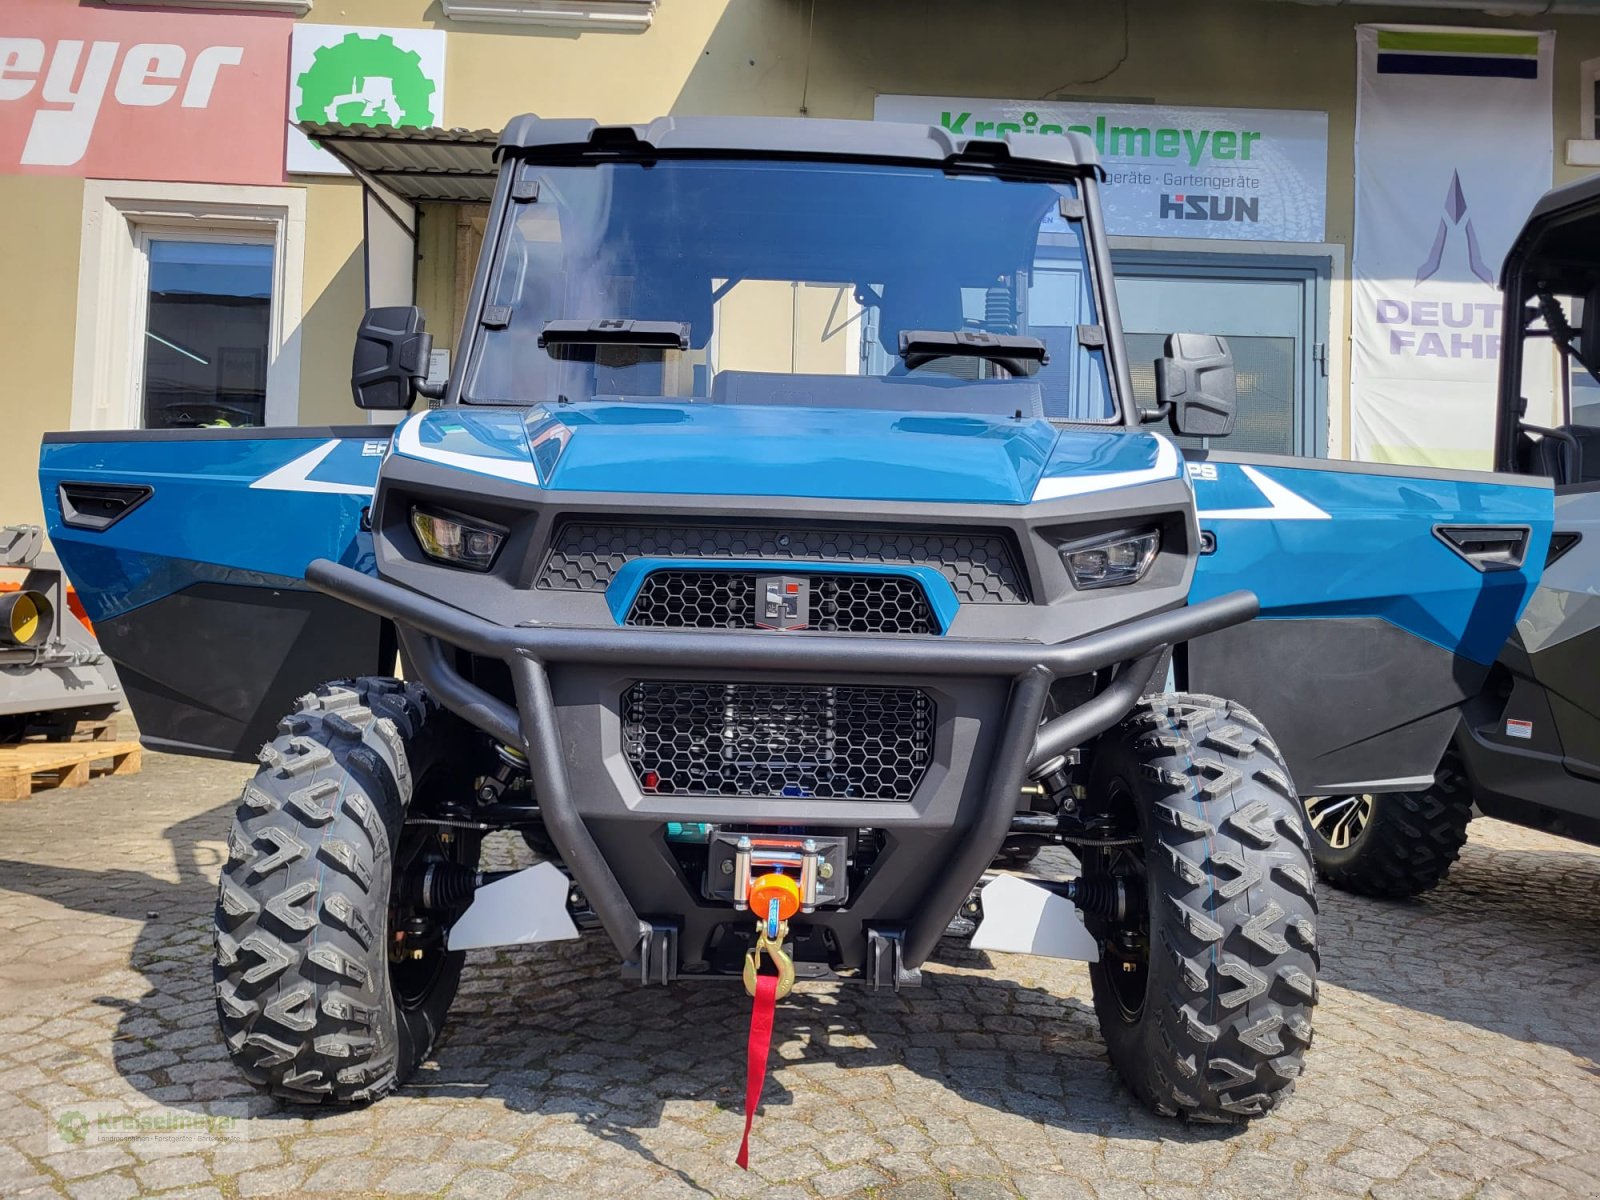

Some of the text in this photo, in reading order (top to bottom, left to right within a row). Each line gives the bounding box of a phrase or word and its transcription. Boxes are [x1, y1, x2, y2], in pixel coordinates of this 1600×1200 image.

[1104, 172, 1260, 190] geräte Gartengeräte
[1375, 299, 1502, 328] DEUT
[1186, 462, 1218, 481] PS
